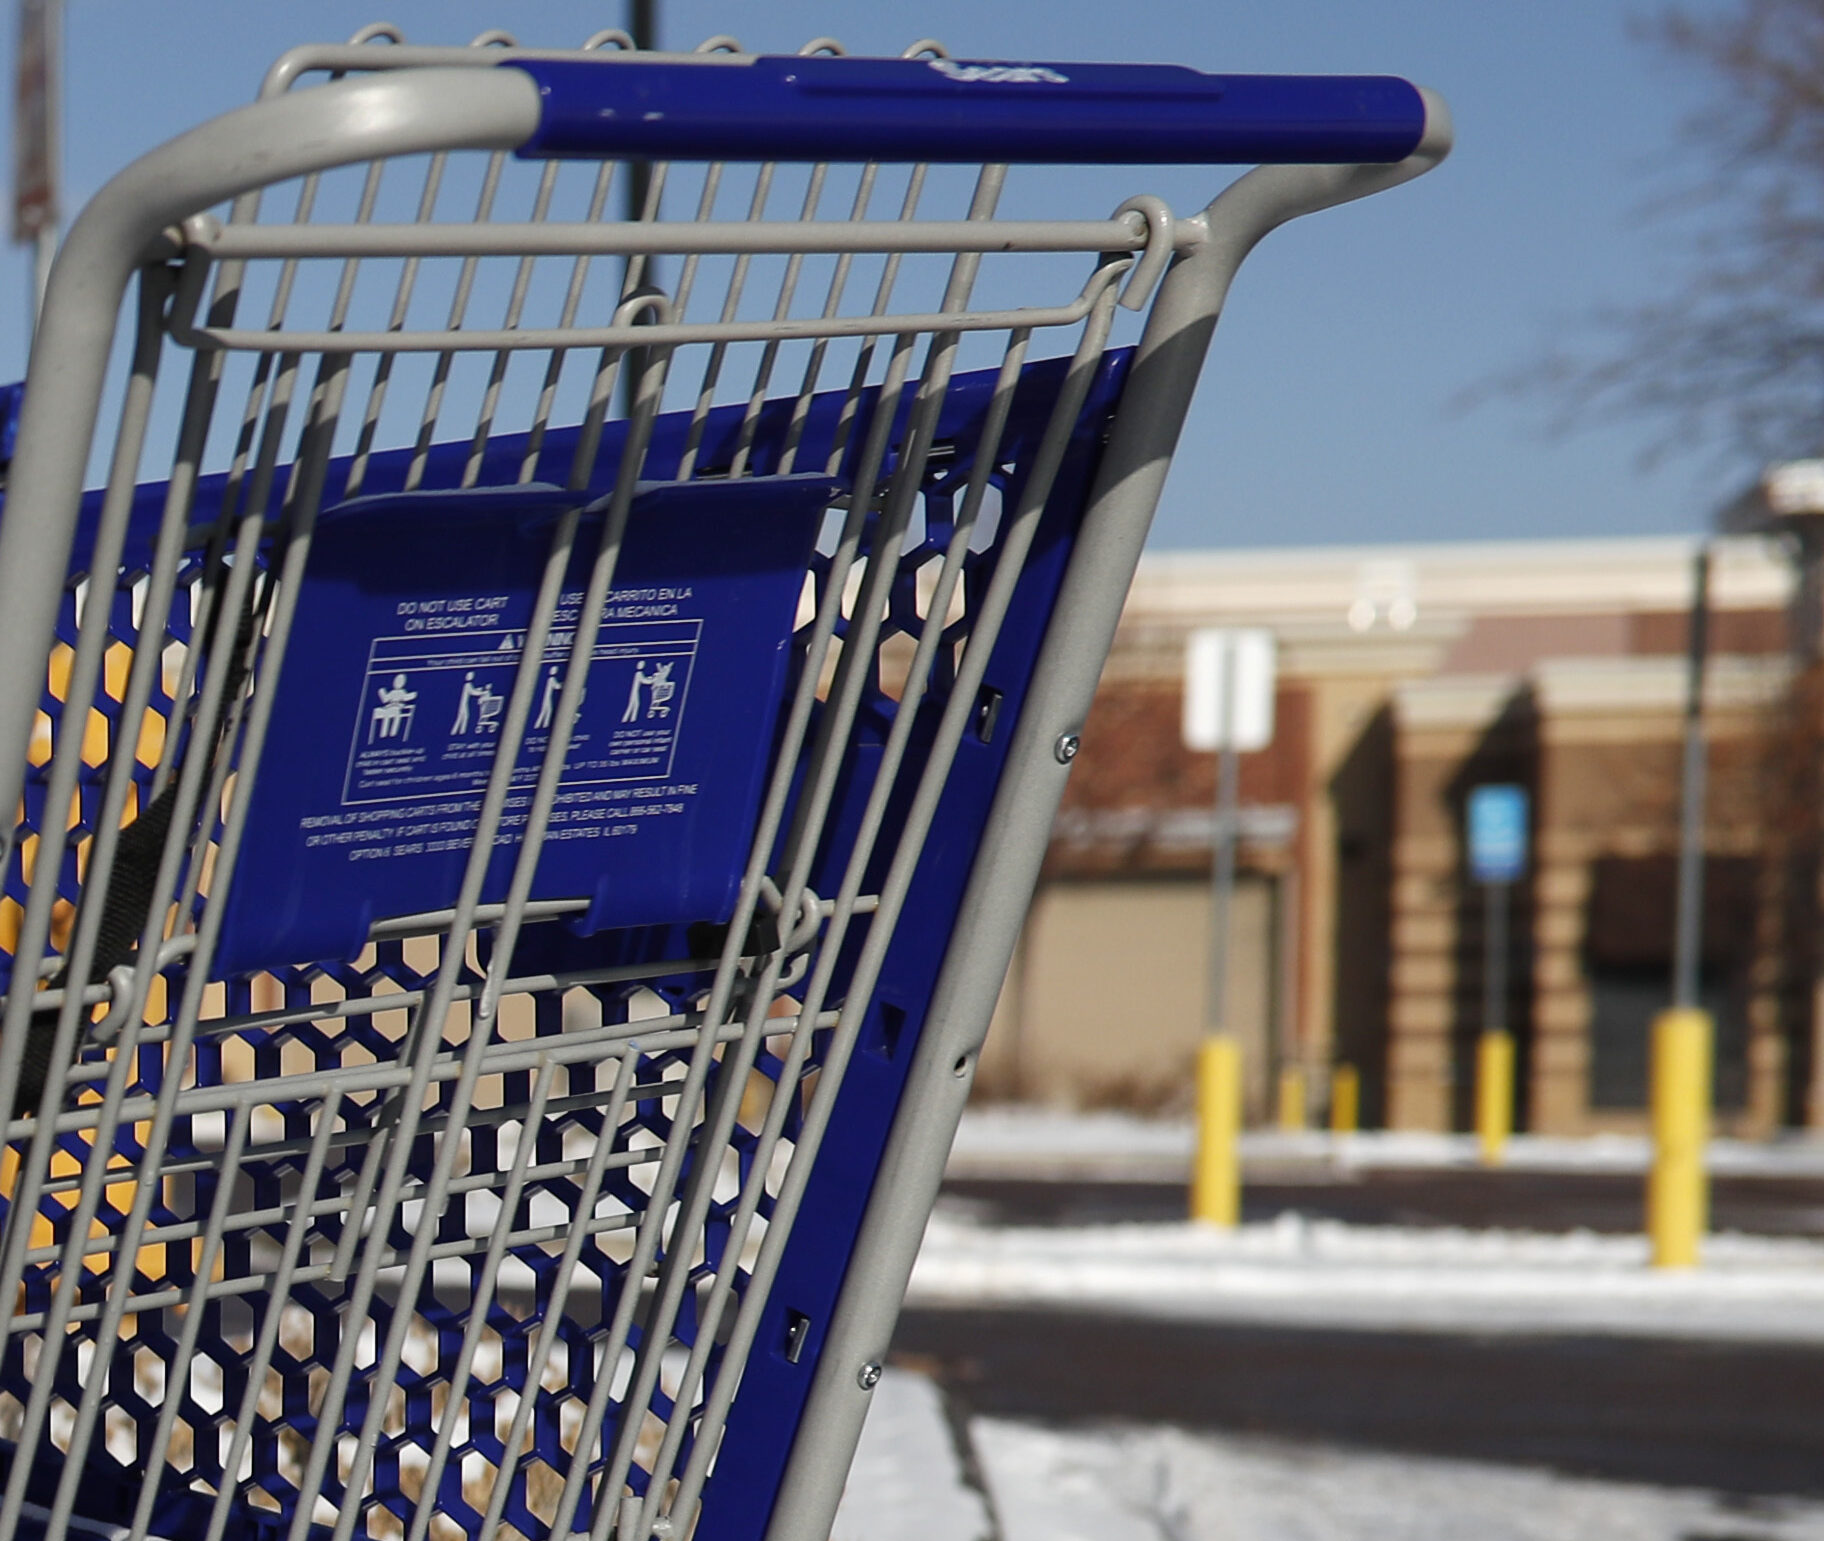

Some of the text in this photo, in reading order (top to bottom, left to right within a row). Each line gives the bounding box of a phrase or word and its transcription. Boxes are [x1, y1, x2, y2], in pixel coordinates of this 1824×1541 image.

[604, 588, 656, 603] CARRITO
[397, 596, 509, 615] DO NOT USE CART
[404, 614, 500, 632] ON ESCALATOR
[492, 834, 512, 846] OAD
